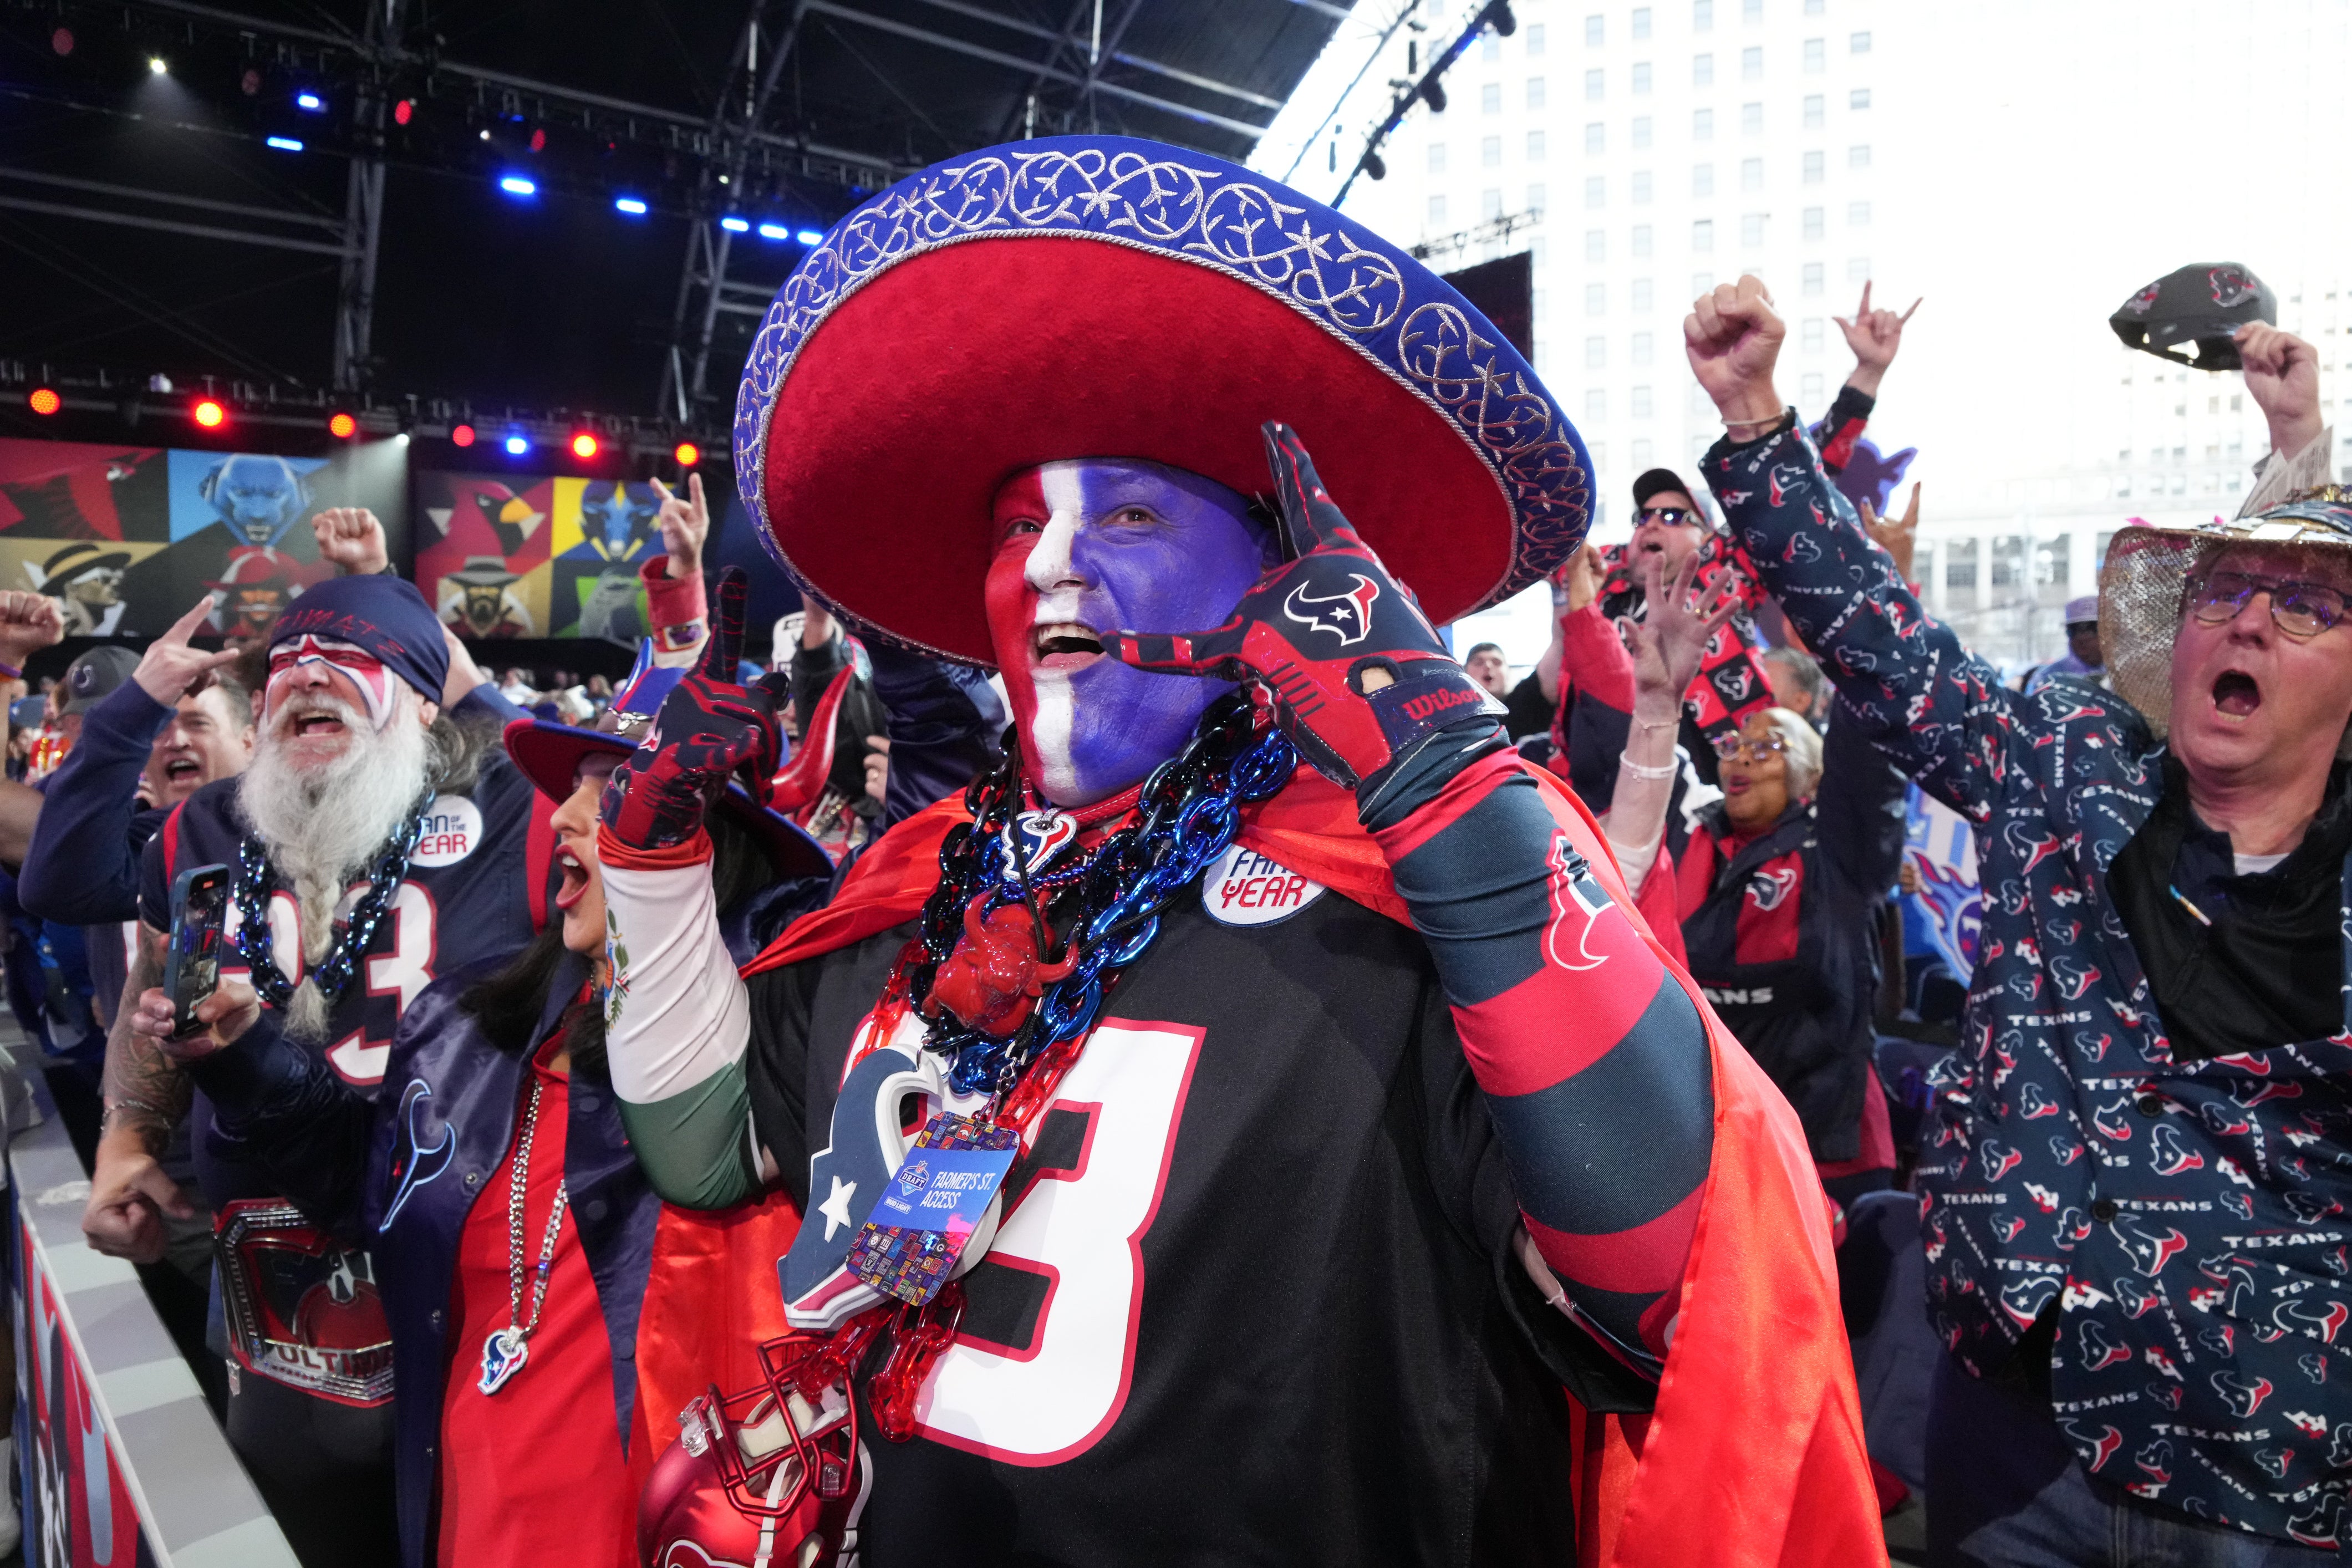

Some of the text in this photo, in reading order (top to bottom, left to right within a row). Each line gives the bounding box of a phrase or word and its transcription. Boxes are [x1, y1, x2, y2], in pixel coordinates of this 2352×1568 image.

[1402, 688, 1484, 720] Wilson
[2054, 722, 2066, 788] TEXANS
[1221, 870, 1307, 909] YEAR
[2246, 1111, 2271, 1182] TEXANS
[902, 1173, 925, 1188] DRAFT
[931, 1171, 996, 1190] FARMER'S ST.
[885, 1198, 897, 1207] BUD
[895, 1202, 910, 1213] LIGHT
[919, 1190, 961, 1209] ACCESS
[1942, 1193, 2008, 1204] TEXANS
[2112, 1198, 2213, 1211] TEXANS
[2221, 1231, 2343, 1249] TEXANS
[2154, 1279, 2196, 1363] TEXANS
[2053, 1391, 2139, 1413] TEXANS
[2150, 1423, 2271, 1442] TEXANS
[2191, 1447, 2257, 1501] TEXANS
